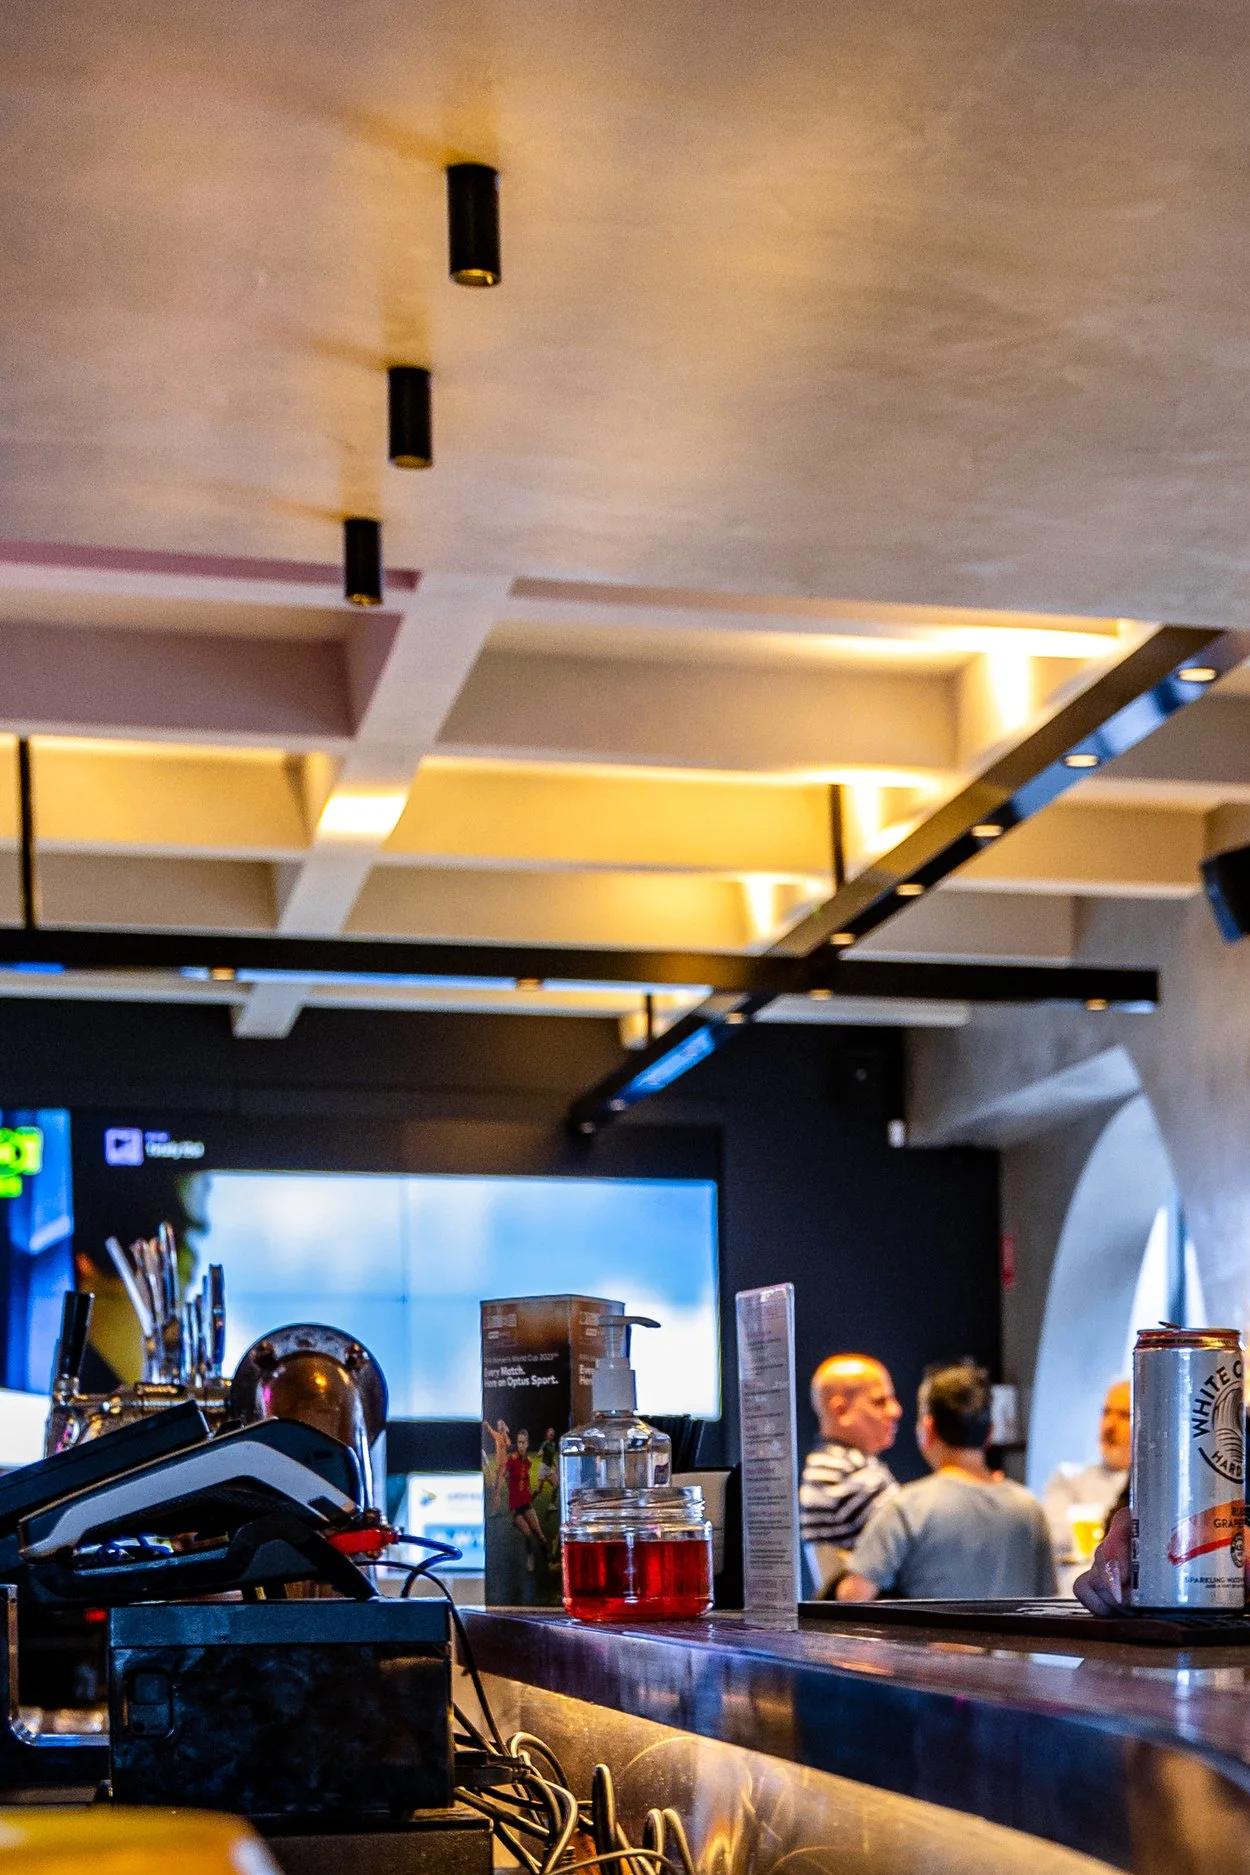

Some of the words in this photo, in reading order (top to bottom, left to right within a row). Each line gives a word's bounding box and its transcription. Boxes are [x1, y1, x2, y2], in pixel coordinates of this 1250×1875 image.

[507, 1377, 530, 1390] Optus
[531, 1374, 559, 1388] Sport.
[1191, 1365, 1230, 1438] WHITE
